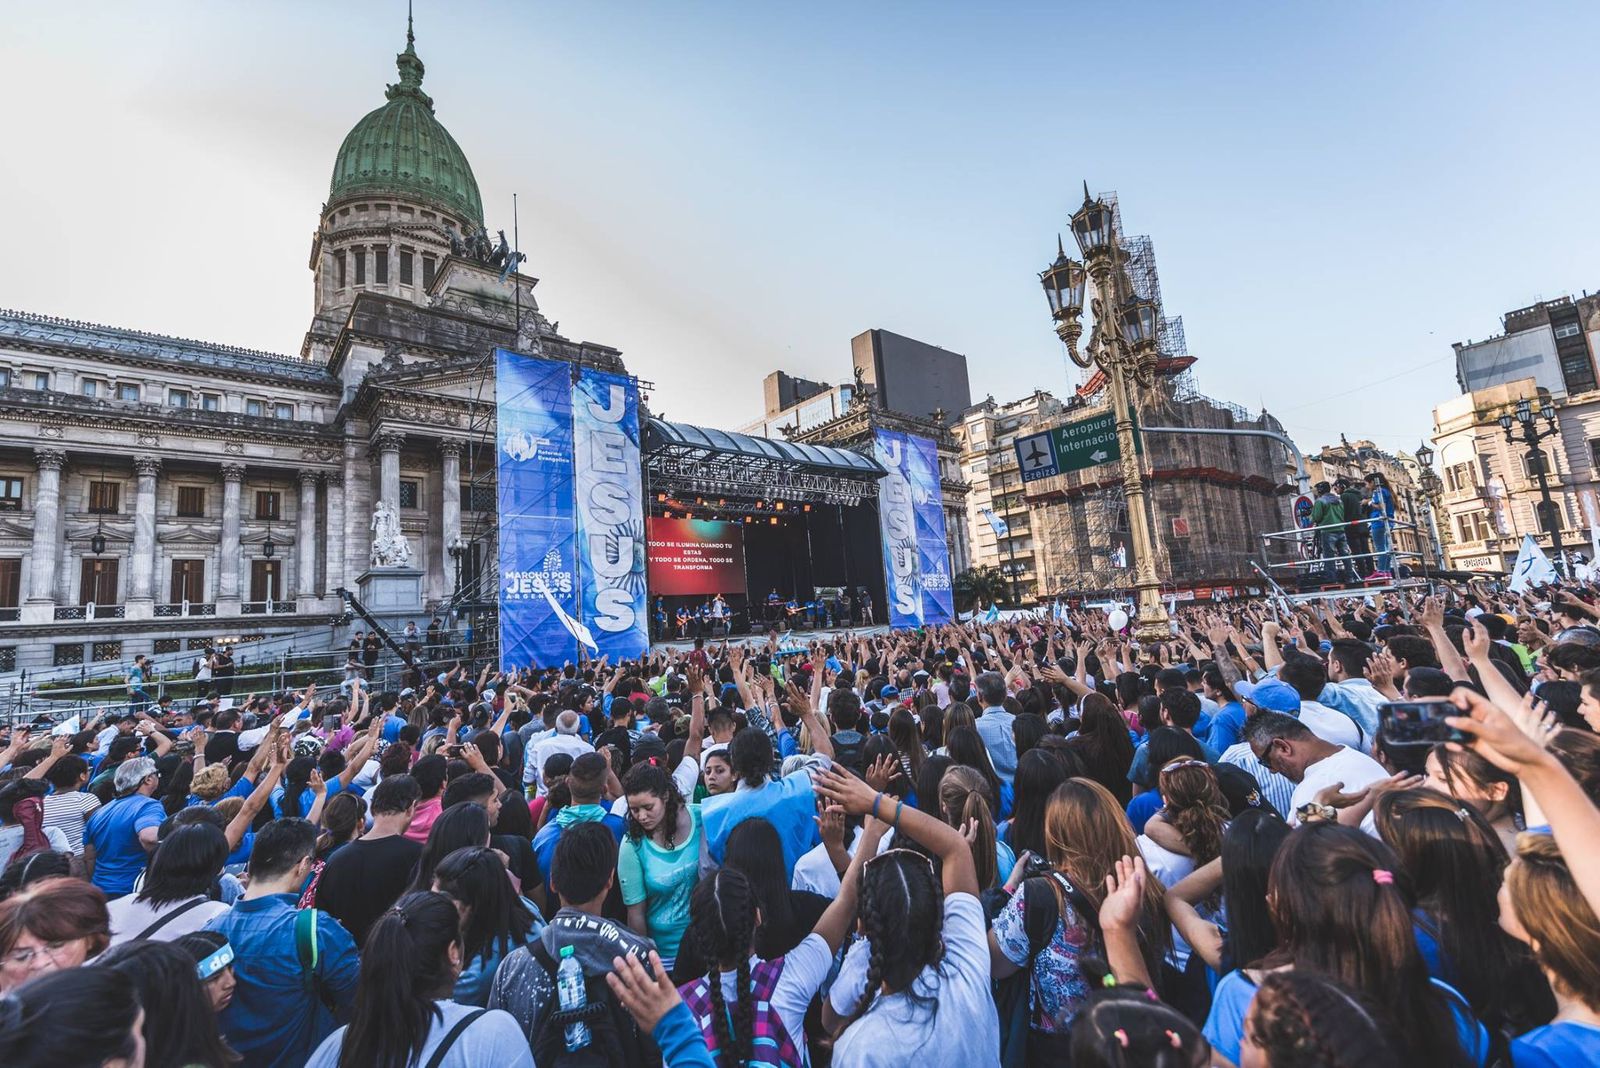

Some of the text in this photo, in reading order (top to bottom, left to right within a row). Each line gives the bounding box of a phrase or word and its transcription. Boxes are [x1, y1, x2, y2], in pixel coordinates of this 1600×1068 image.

[1062, 415, 1117, 438] Aeropuert
[1059, 431, 1120, 454] Internacio
[1023, 468, 1056, 482] Ezeiza
[587, 385, 635, 632] JESUS
[883, 440, 916, 615] JESUS
[551, 571, 571, 579] POR
